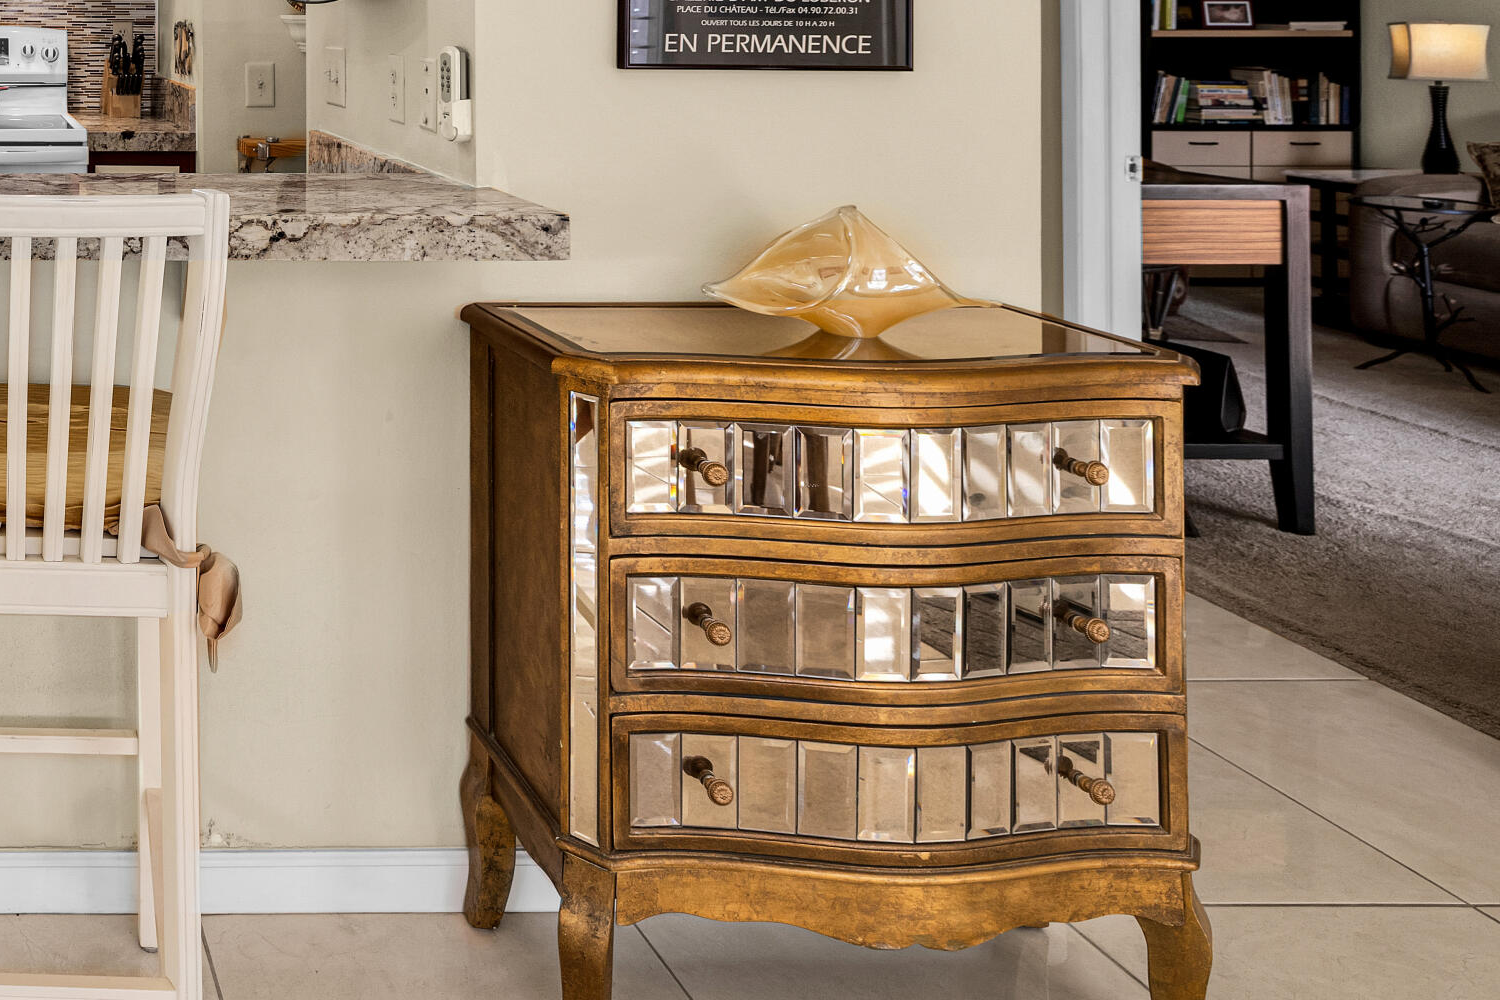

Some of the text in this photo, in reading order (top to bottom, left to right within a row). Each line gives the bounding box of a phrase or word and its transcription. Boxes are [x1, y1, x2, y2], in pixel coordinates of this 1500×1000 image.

[676, 5, 702, 13] PLACE
[719, 4, 758, 14] CHÂTEAU
[797, 6, 858, 15] 04.90.72.00.31
[664, 33, 872, 54] EN PERMANENCE
